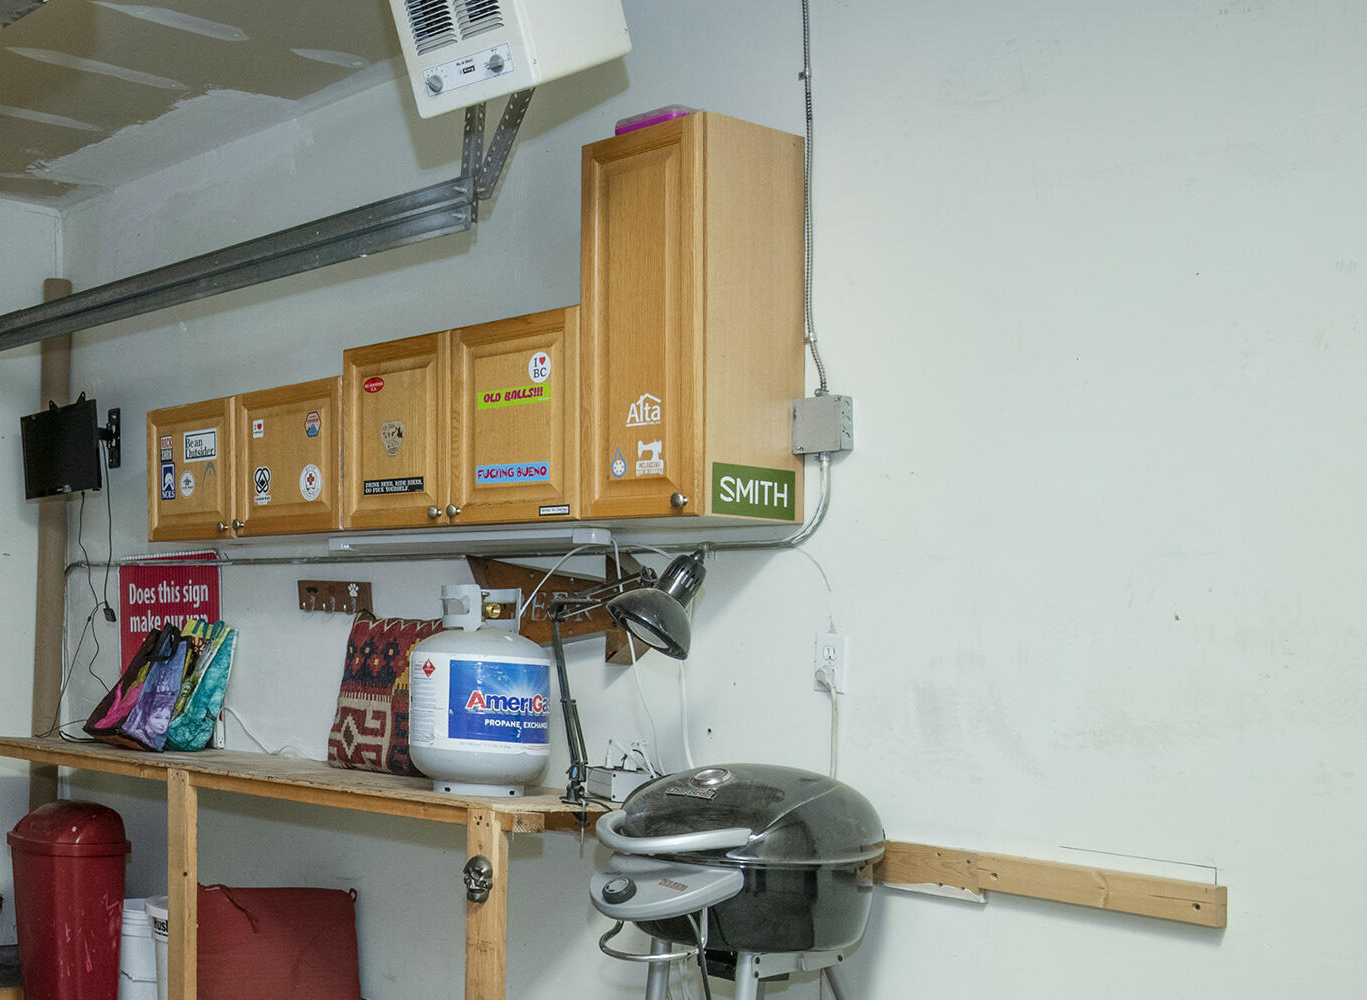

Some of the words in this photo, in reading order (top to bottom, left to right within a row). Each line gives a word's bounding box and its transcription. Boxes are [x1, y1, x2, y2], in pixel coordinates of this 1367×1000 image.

[533, 358, 539, 367] I
[533, 367, 547, 378] BC
[483, 393, 501, 403] OLD
[504, 386, 543, 401] BALLS!!!
[626, 393, 661, 424] Alta
[477, 467, 515, 479] FUCKING
[516, 466, 547, 477] BUENO
[719, 475, 788, 508] SMITH
[129, 583, 156, 605] Does
[158, 580, 181, 603] this
[183, 579, 209, 608] sign
[130, 609, 162, 632] make
[464, 690, 551, 714] AmeriGa
[484, 719, 521, 728] PROPANE
